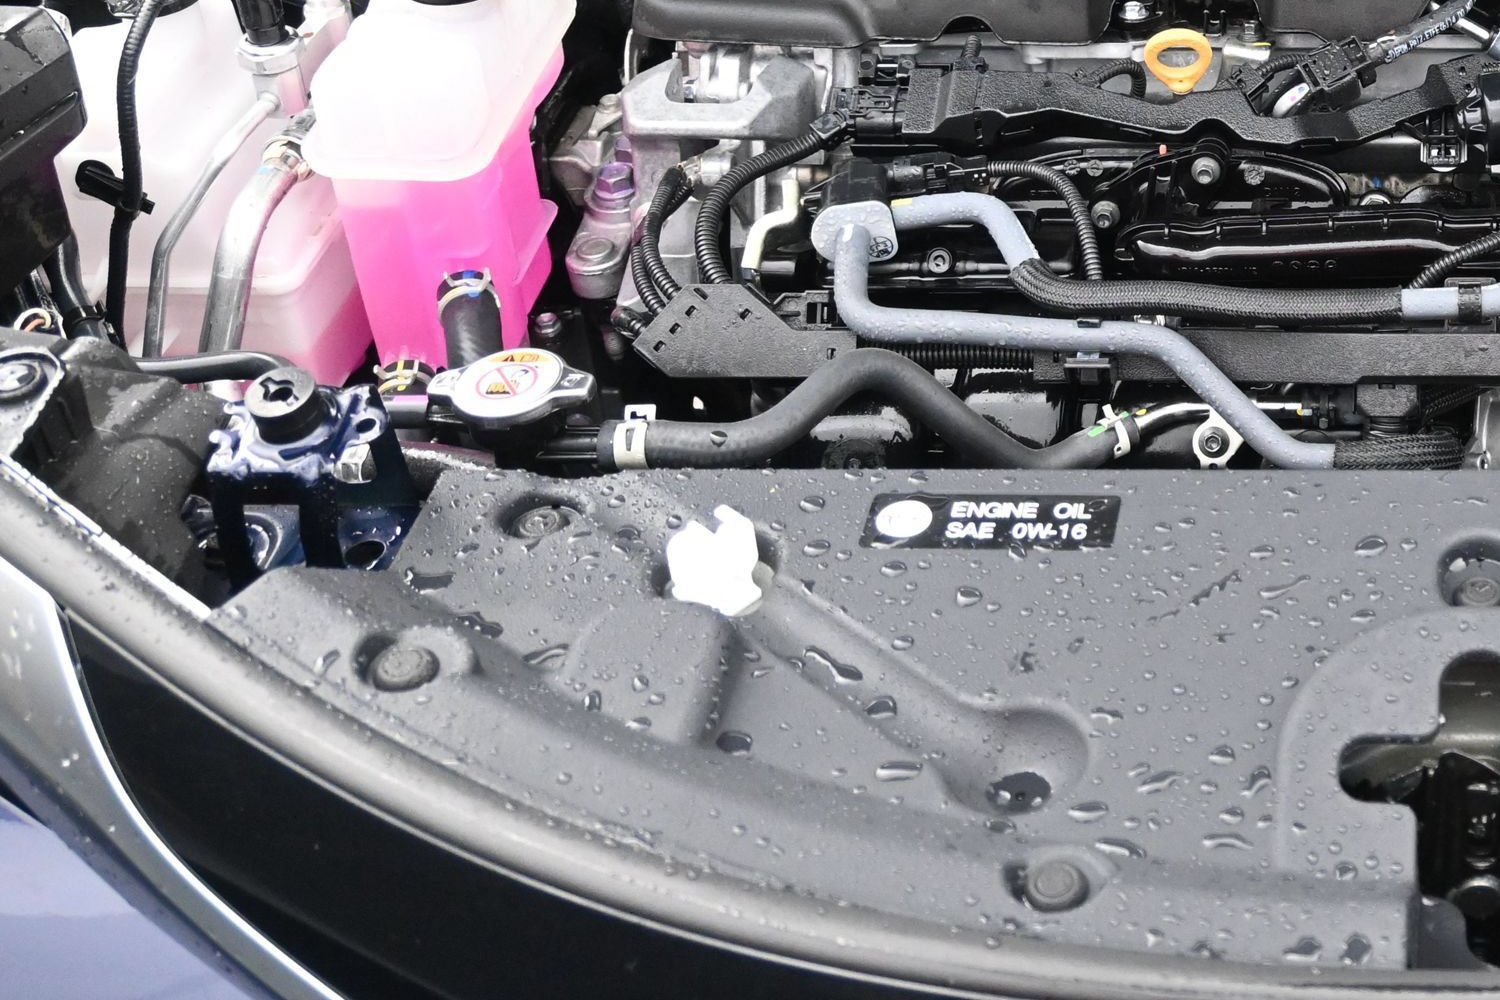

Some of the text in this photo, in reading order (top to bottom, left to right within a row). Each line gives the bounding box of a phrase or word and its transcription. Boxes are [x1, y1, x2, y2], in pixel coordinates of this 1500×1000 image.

[950, 501, 1092, 520] ENGINE OIL
[945, 522, 1088, 540] SAE 0W-16
